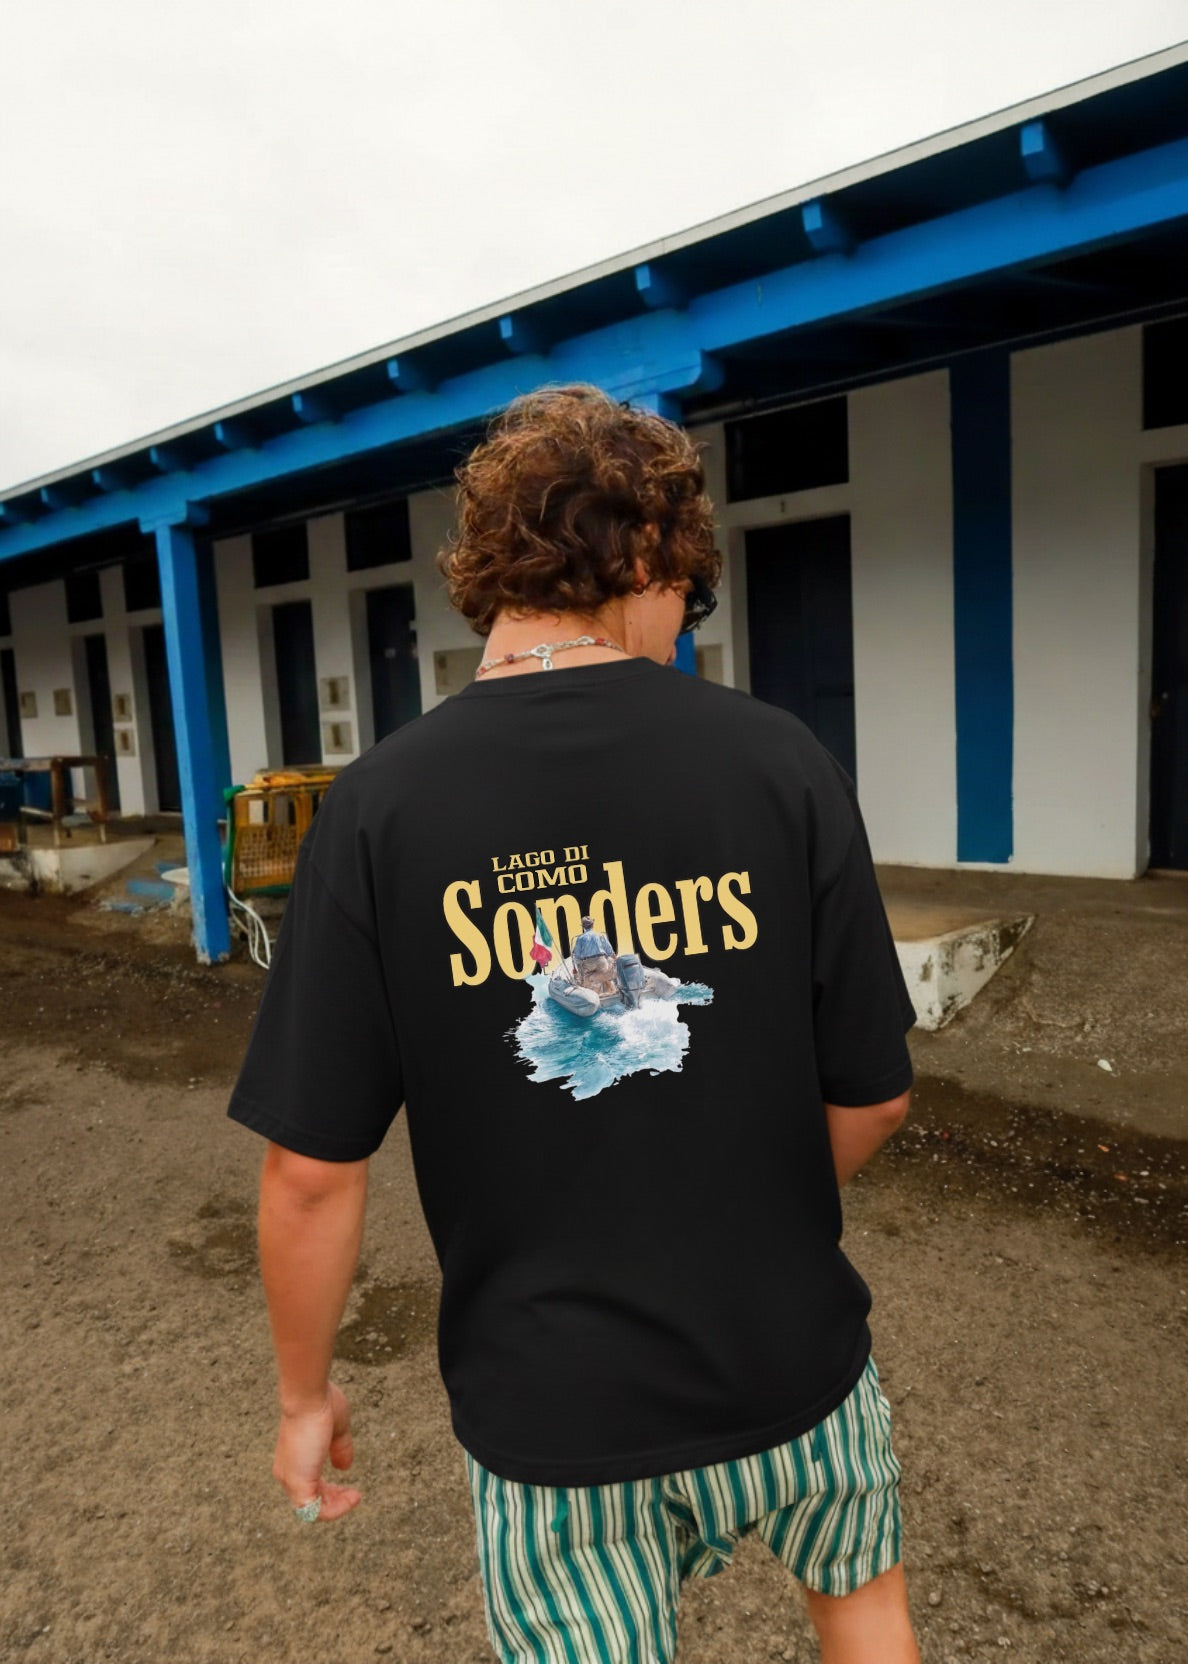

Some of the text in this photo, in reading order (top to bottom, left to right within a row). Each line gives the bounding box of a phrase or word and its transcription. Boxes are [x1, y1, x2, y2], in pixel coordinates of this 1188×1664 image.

[491, 845, 590, 872] LAGO DI
[497, 863, 588, 894] COMO
[442, 860, 758, 987] Sonders
